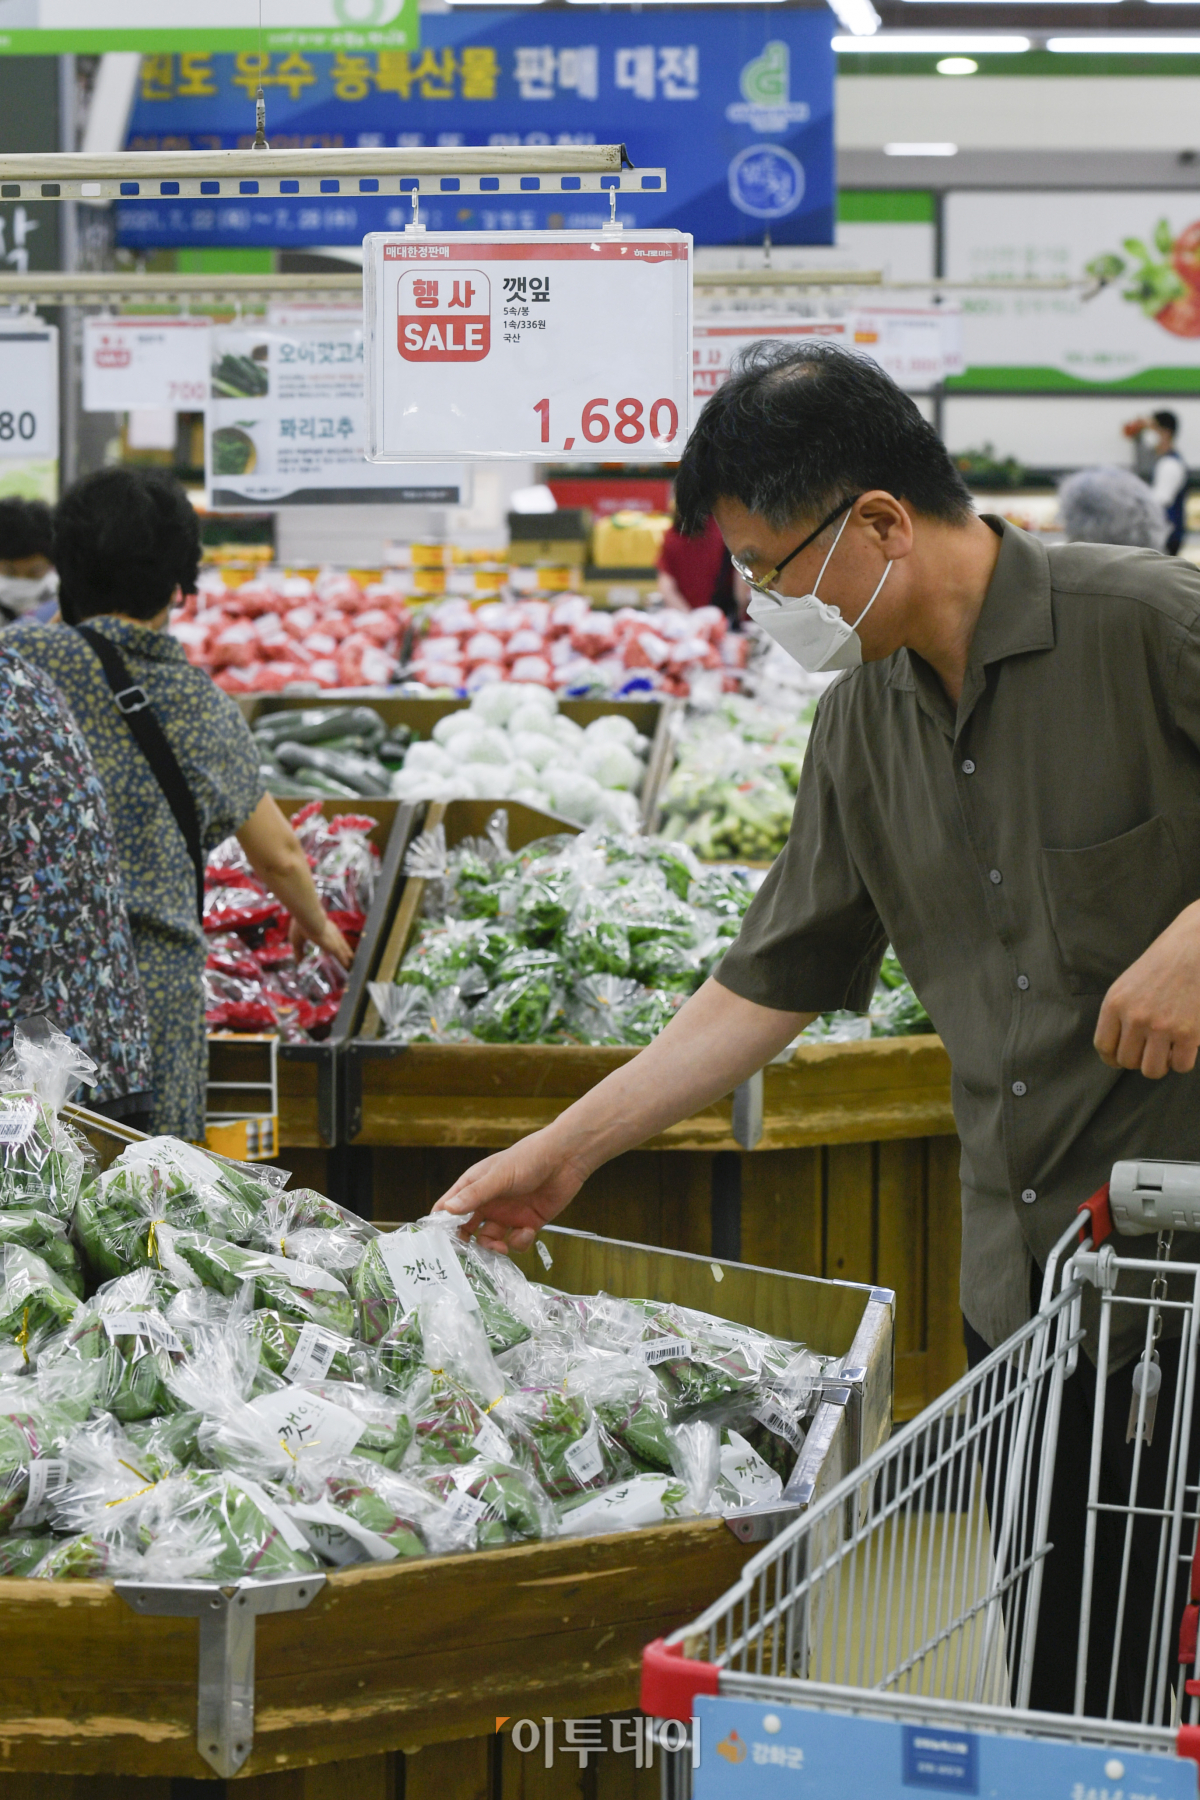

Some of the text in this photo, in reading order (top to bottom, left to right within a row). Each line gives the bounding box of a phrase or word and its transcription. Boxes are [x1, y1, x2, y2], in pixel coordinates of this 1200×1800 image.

[514, 46, 599, 99] 판매
[615, 46, 699, 99] 대전
[386, 246, 450, 258] 매대한정판매
[633, 248, 673, 257] 하나로마트
[502, 276, 551, 303] 깻잎
[503, 306, 530, 317] 5속/봉
[503, 319, 546, 330] 1속/336원
[404, 322, 484, 352] SALE
[503, 333, 521, 343] 국산
[533, 397, 679, 450] 1,680
[402, 1257, 448, 1285] 깻잎
